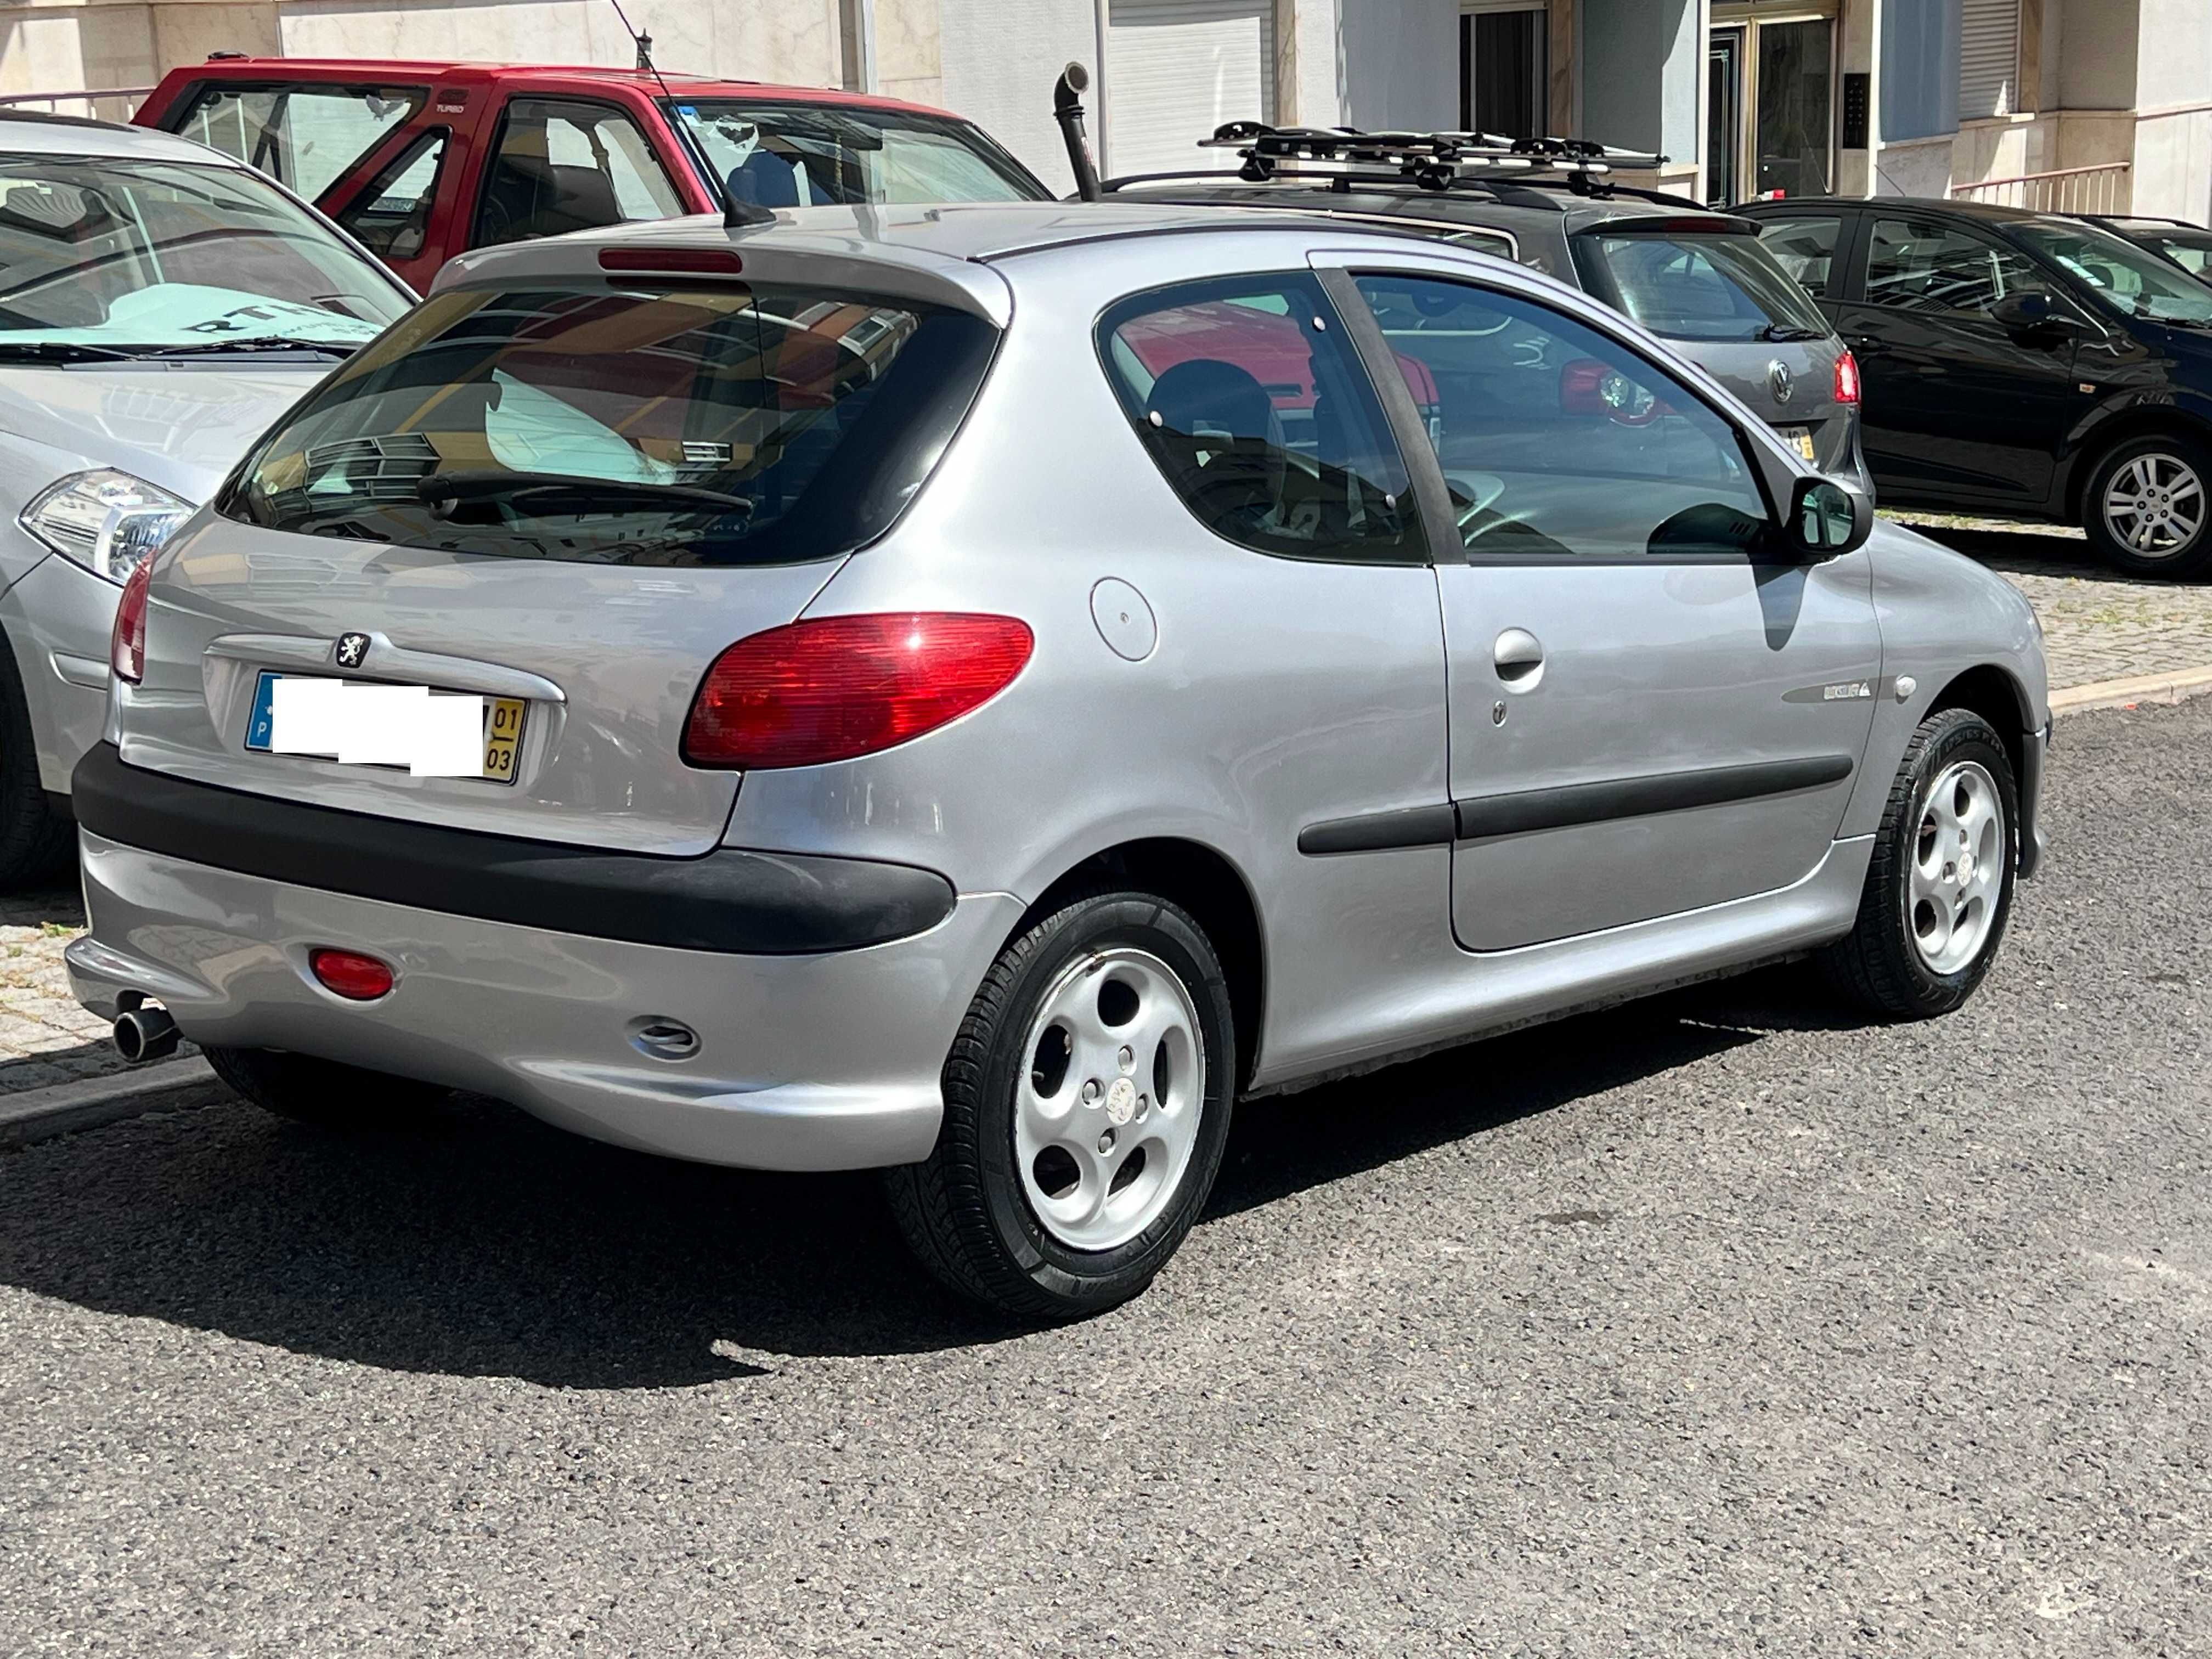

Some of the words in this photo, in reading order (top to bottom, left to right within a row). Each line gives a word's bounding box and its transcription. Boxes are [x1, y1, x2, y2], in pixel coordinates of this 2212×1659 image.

[436, 104, 464, 113] TURBO
[495, 708, 517, 730] 01
[257, 721, 267, 737] P
[487, 748, 510, 770] 03
